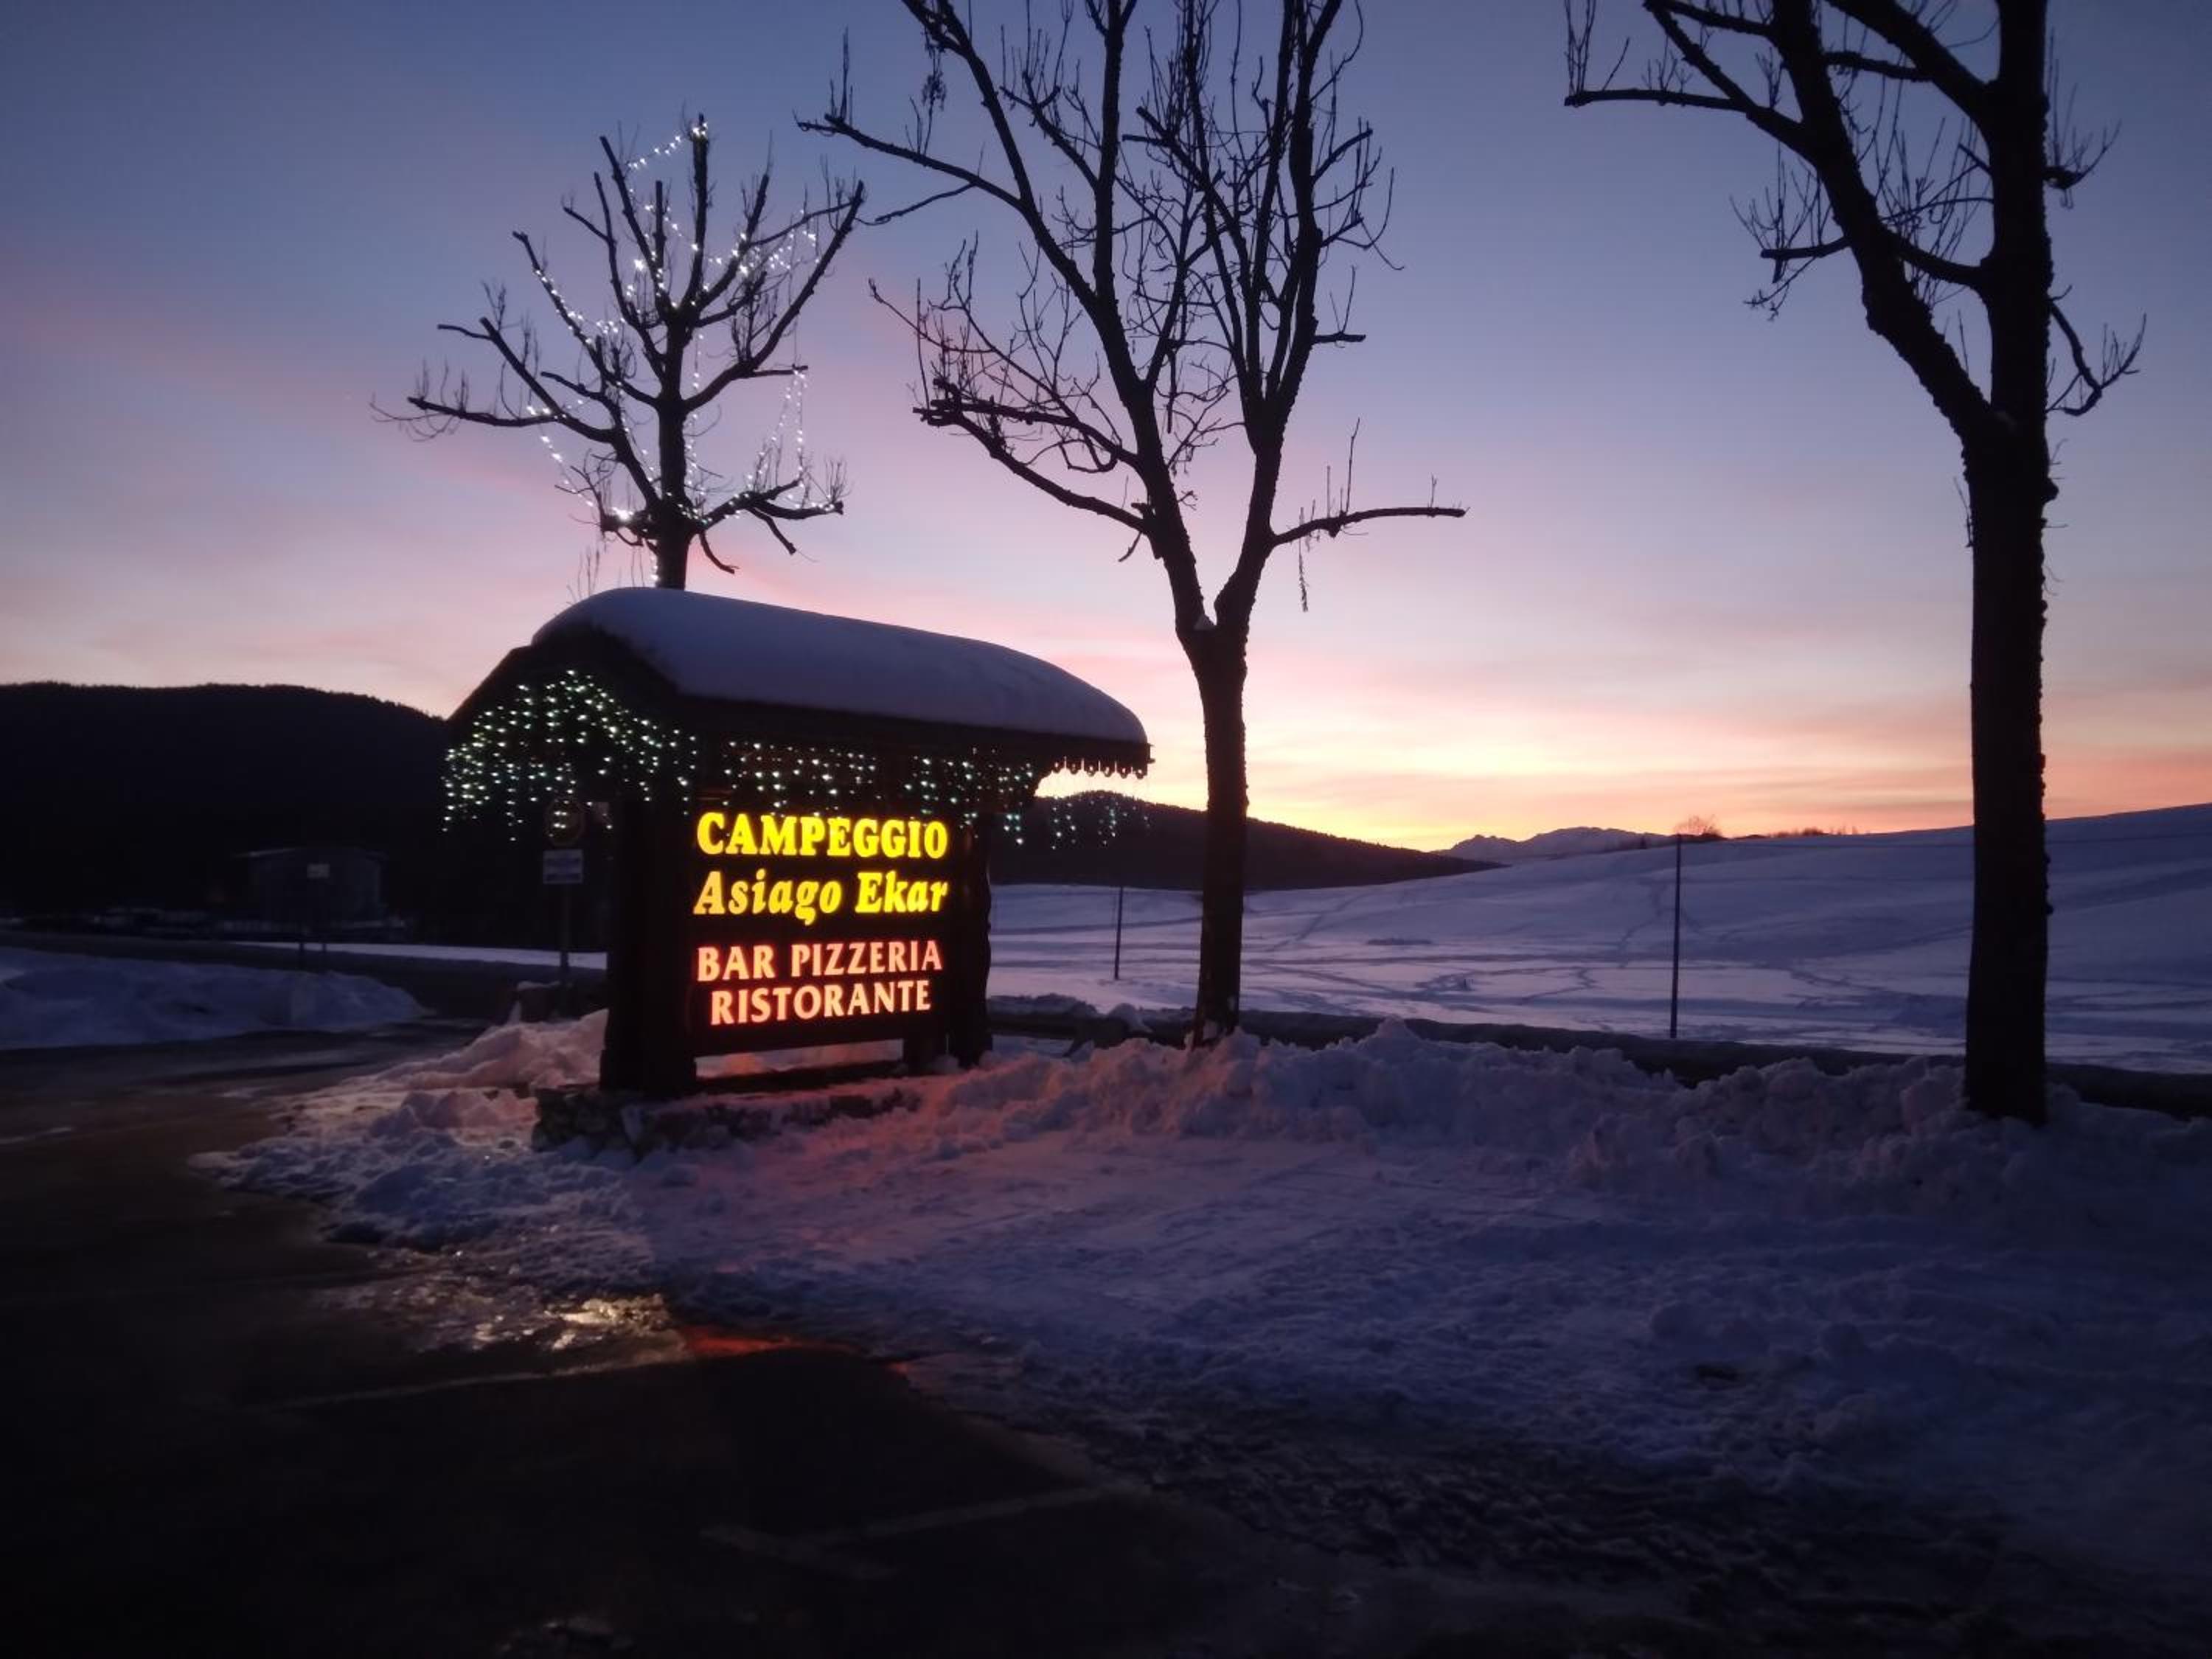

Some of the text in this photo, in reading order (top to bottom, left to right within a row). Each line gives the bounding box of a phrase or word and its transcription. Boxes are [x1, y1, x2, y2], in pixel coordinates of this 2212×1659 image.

[697, 812, 948, 858] CAMPEGGIO
[693, 869, 948, 925] Asiago Ekar
[698, 940, 942, 982] BAR PIZZERIA
[710, 980, 931, 1025] RISTORANTE
